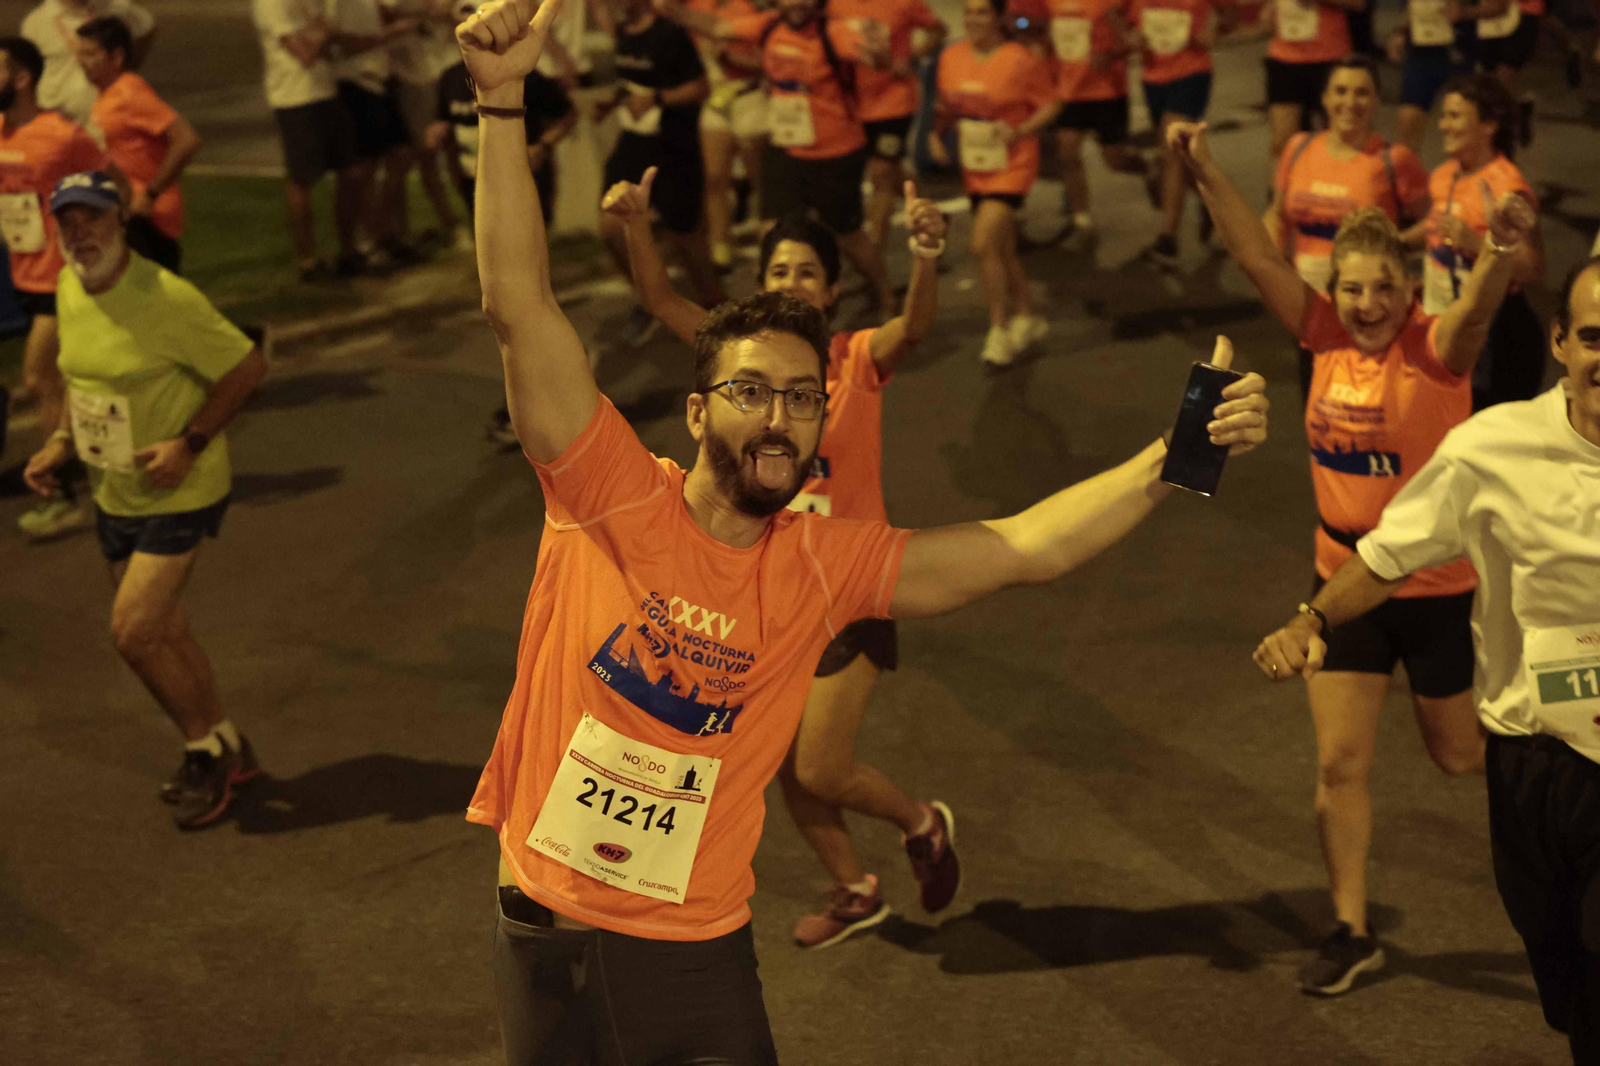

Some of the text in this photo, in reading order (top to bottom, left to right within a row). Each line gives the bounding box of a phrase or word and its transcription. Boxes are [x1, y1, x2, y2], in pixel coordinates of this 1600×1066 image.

[682, 632, 755, 662] NOCTURNA
[591, 662, 612, 682] 2023
[584, 759, 605, 775] CARRERA
[605, 770, 634, 787] NOCTURNA
[634, 782, 645, 791] DEL
[576, 777, 676, 835] 21214
